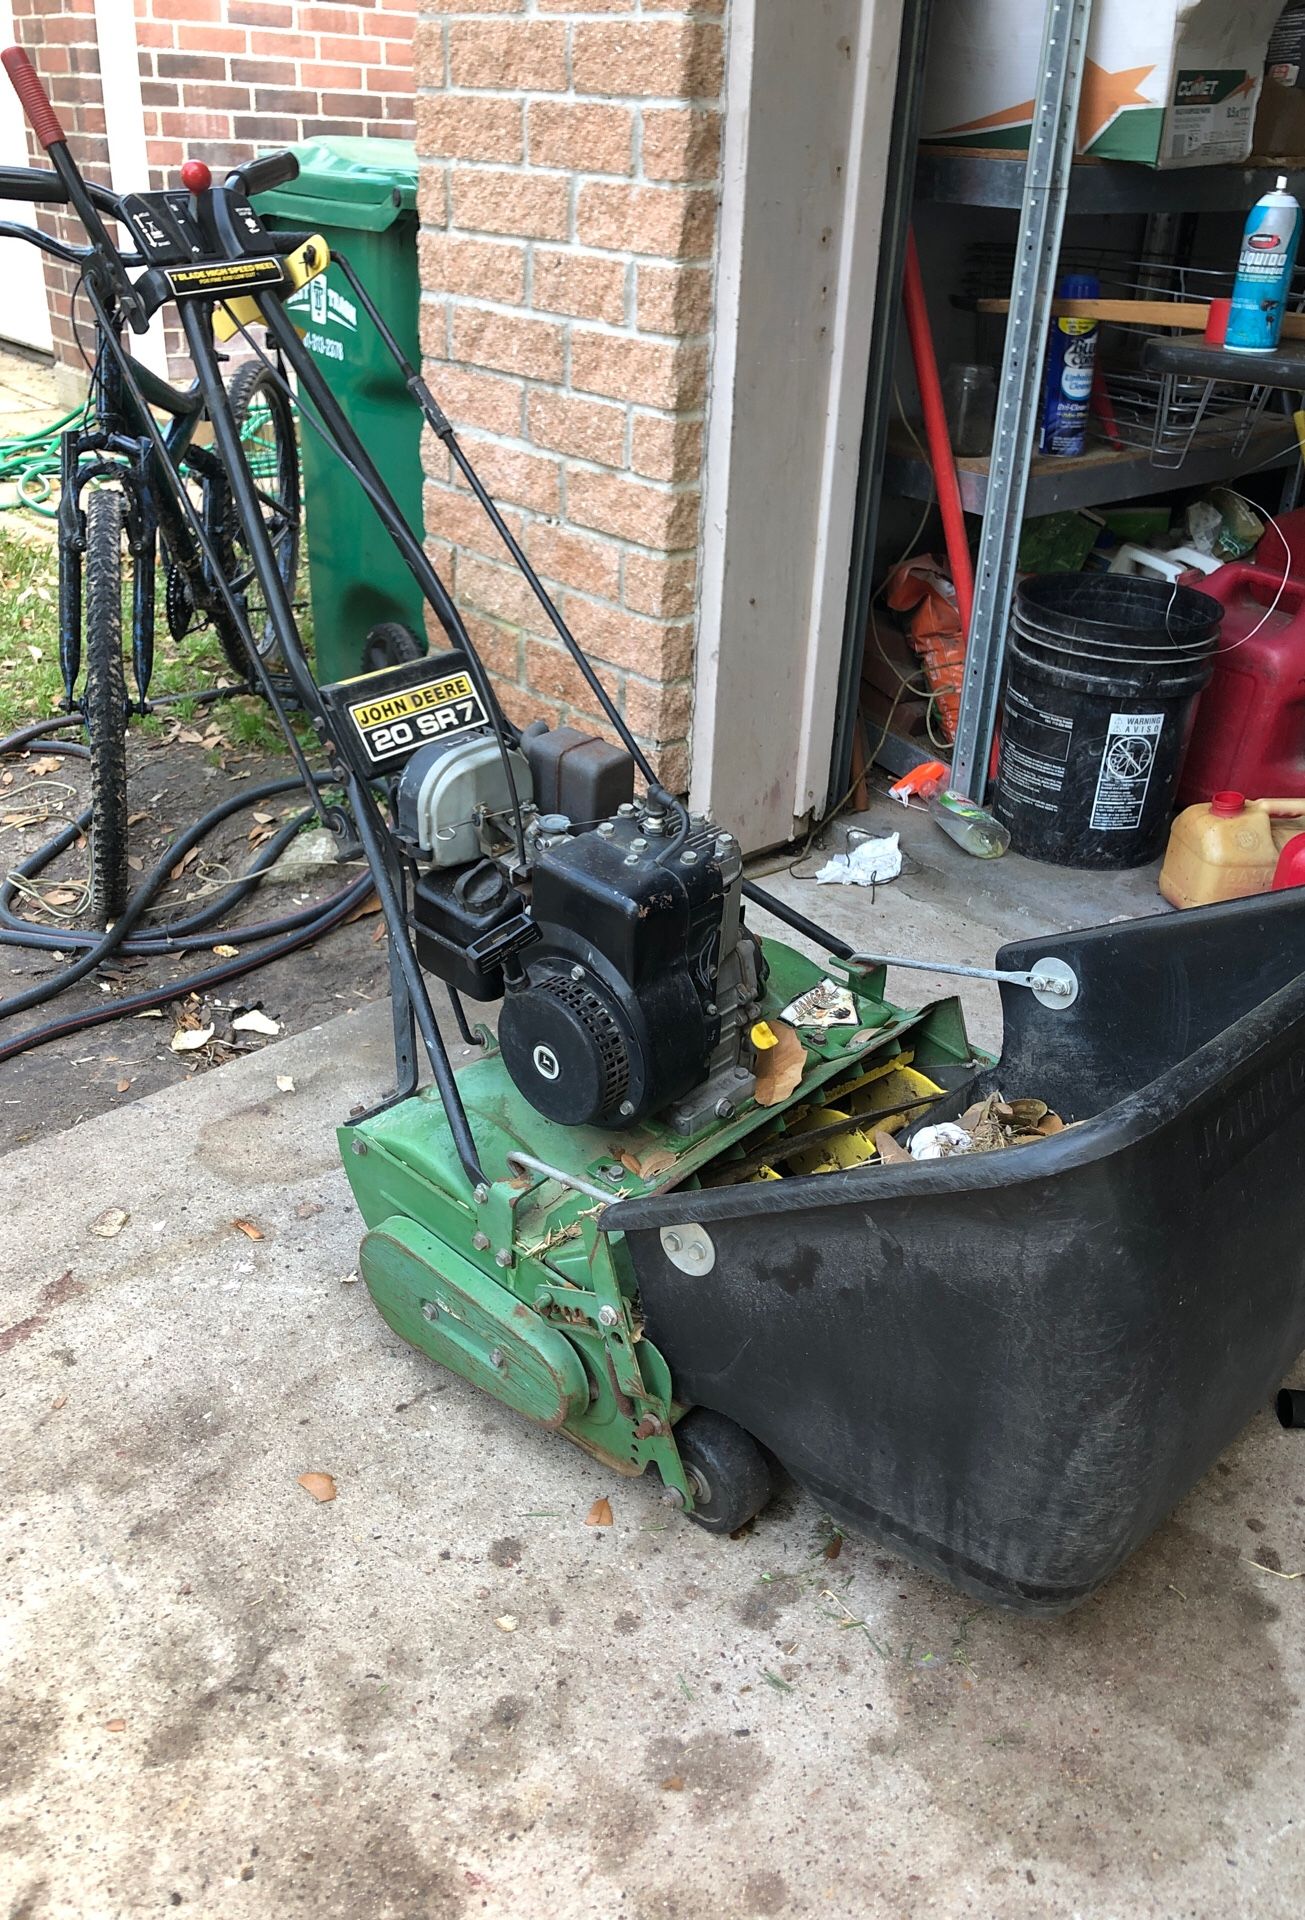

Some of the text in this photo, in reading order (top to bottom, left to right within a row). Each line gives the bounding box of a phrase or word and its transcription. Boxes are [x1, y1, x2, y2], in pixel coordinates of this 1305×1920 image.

[1177, 80, 1220, 96] COMET
[178, 271, 206, 281] BLADE
[206, 268, 228, 277] HIGH
[228, 264, 255, 274] SPEED
[361, 680, 467, 725] JOHN DEERE
[1127, 717, 1161, 725] WARNING
[371, 723, 413, 752] 20
